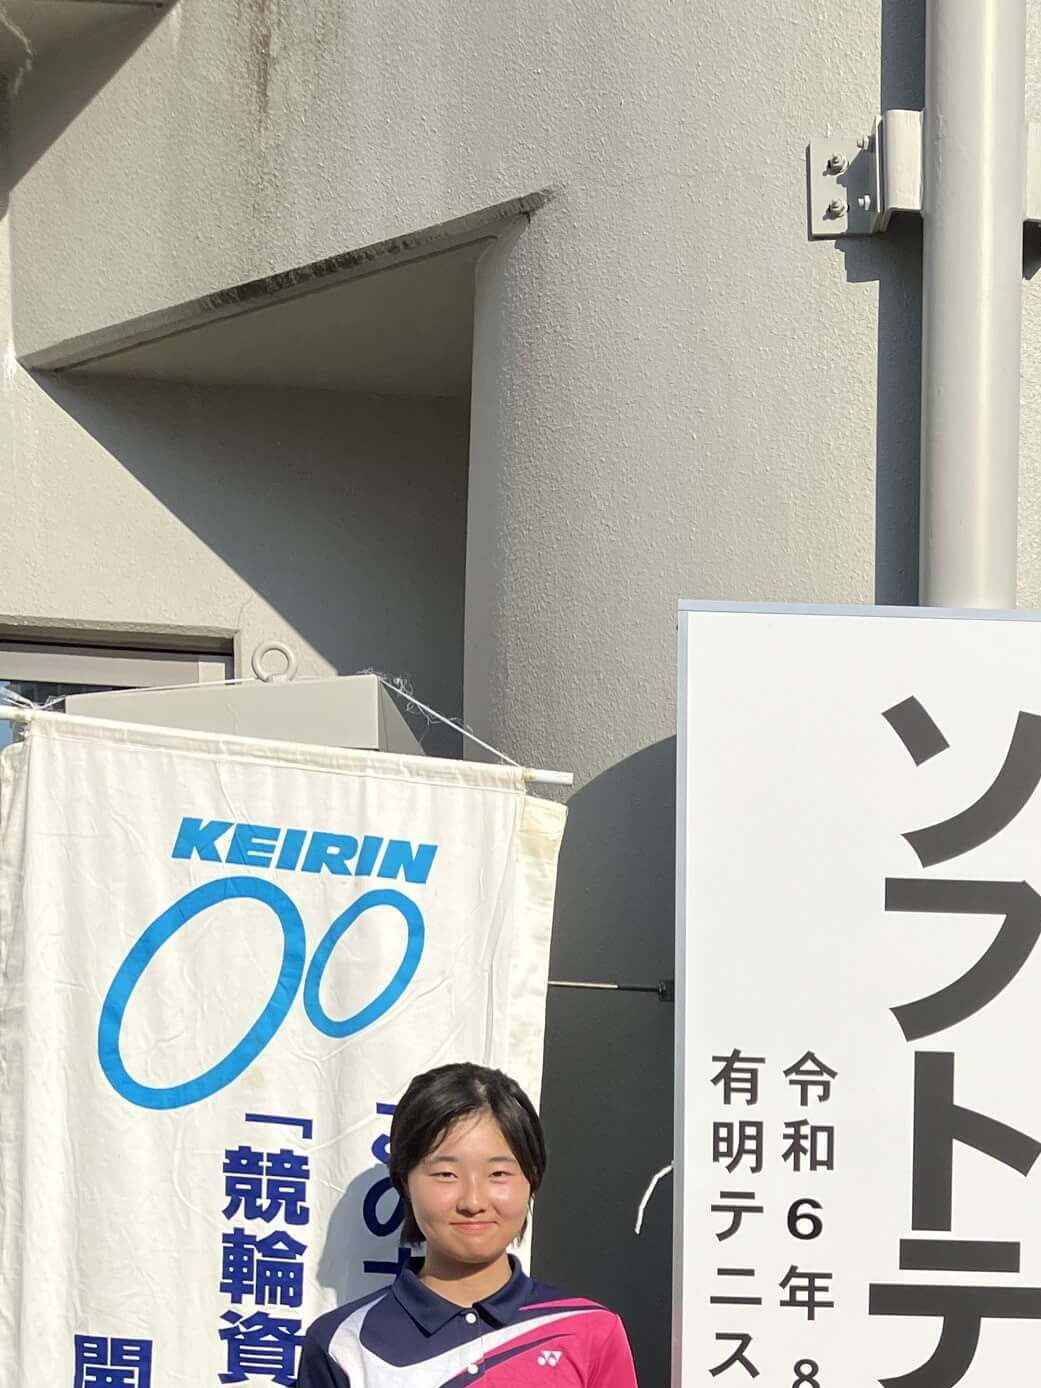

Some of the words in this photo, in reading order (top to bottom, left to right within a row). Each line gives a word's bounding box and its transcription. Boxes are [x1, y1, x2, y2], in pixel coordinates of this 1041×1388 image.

[172, 817, 437, 884] KEIRIN
[779, 1051, 838, 1321] 令和6年
